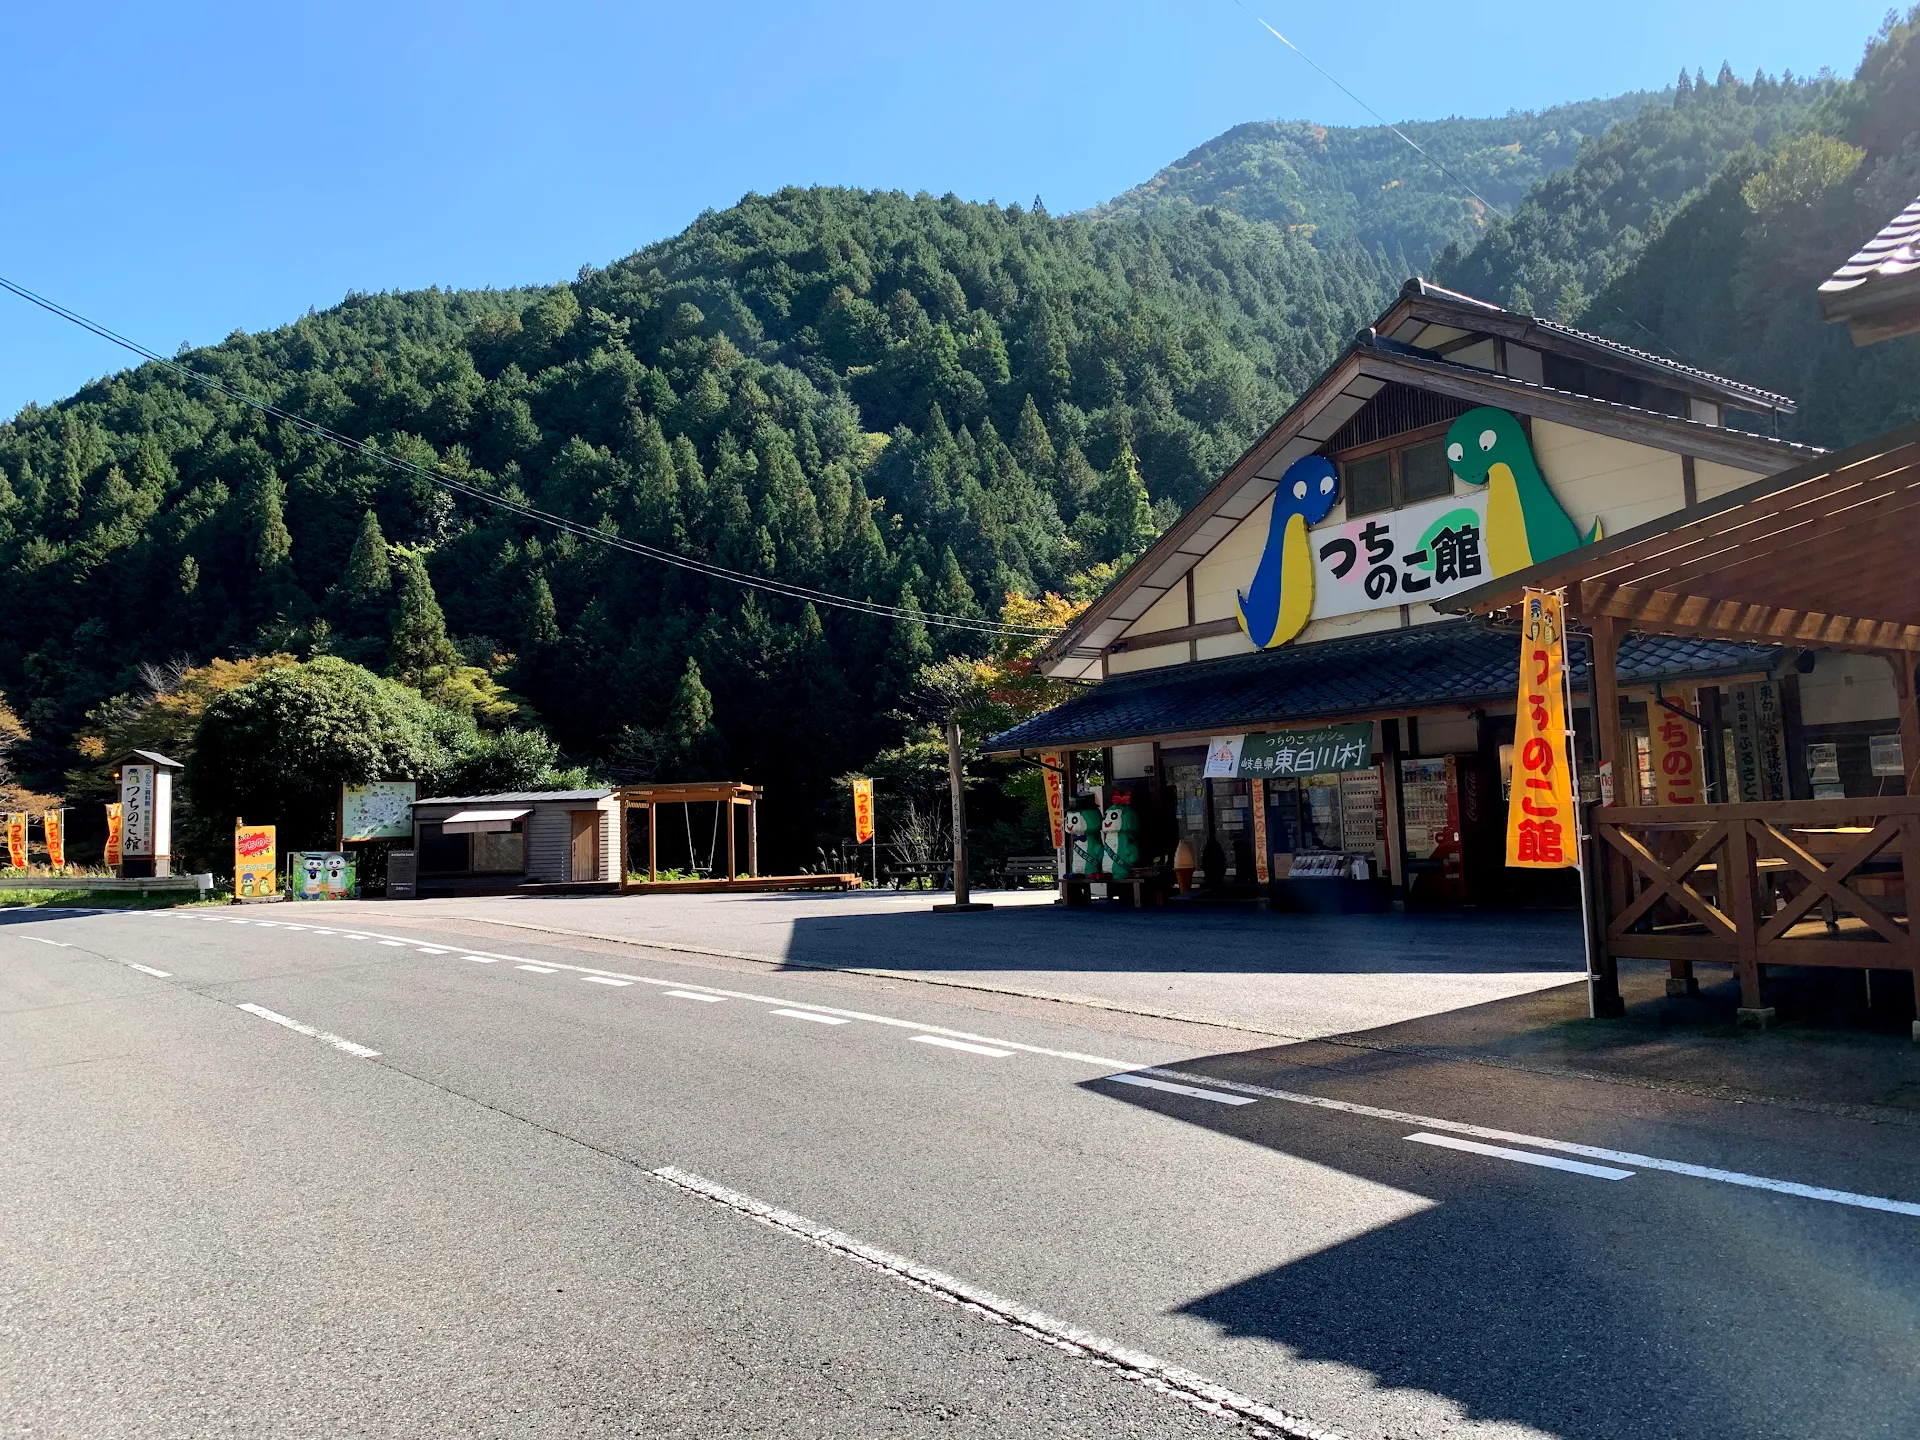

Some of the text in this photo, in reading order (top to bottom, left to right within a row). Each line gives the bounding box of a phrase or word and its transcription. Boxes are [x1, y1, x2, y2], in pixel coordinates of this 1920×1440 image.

[1320, 521, 1482, 601] つちのこ館
[1240, 738, 1367, 774] 岐阜県東白川村
[1265, 731, 1346, 747] つちのこマルシェ
[1736, 691, 1759, 802] 株式会社ふるさと
[125, 785, 142, 851] つちのこ館
